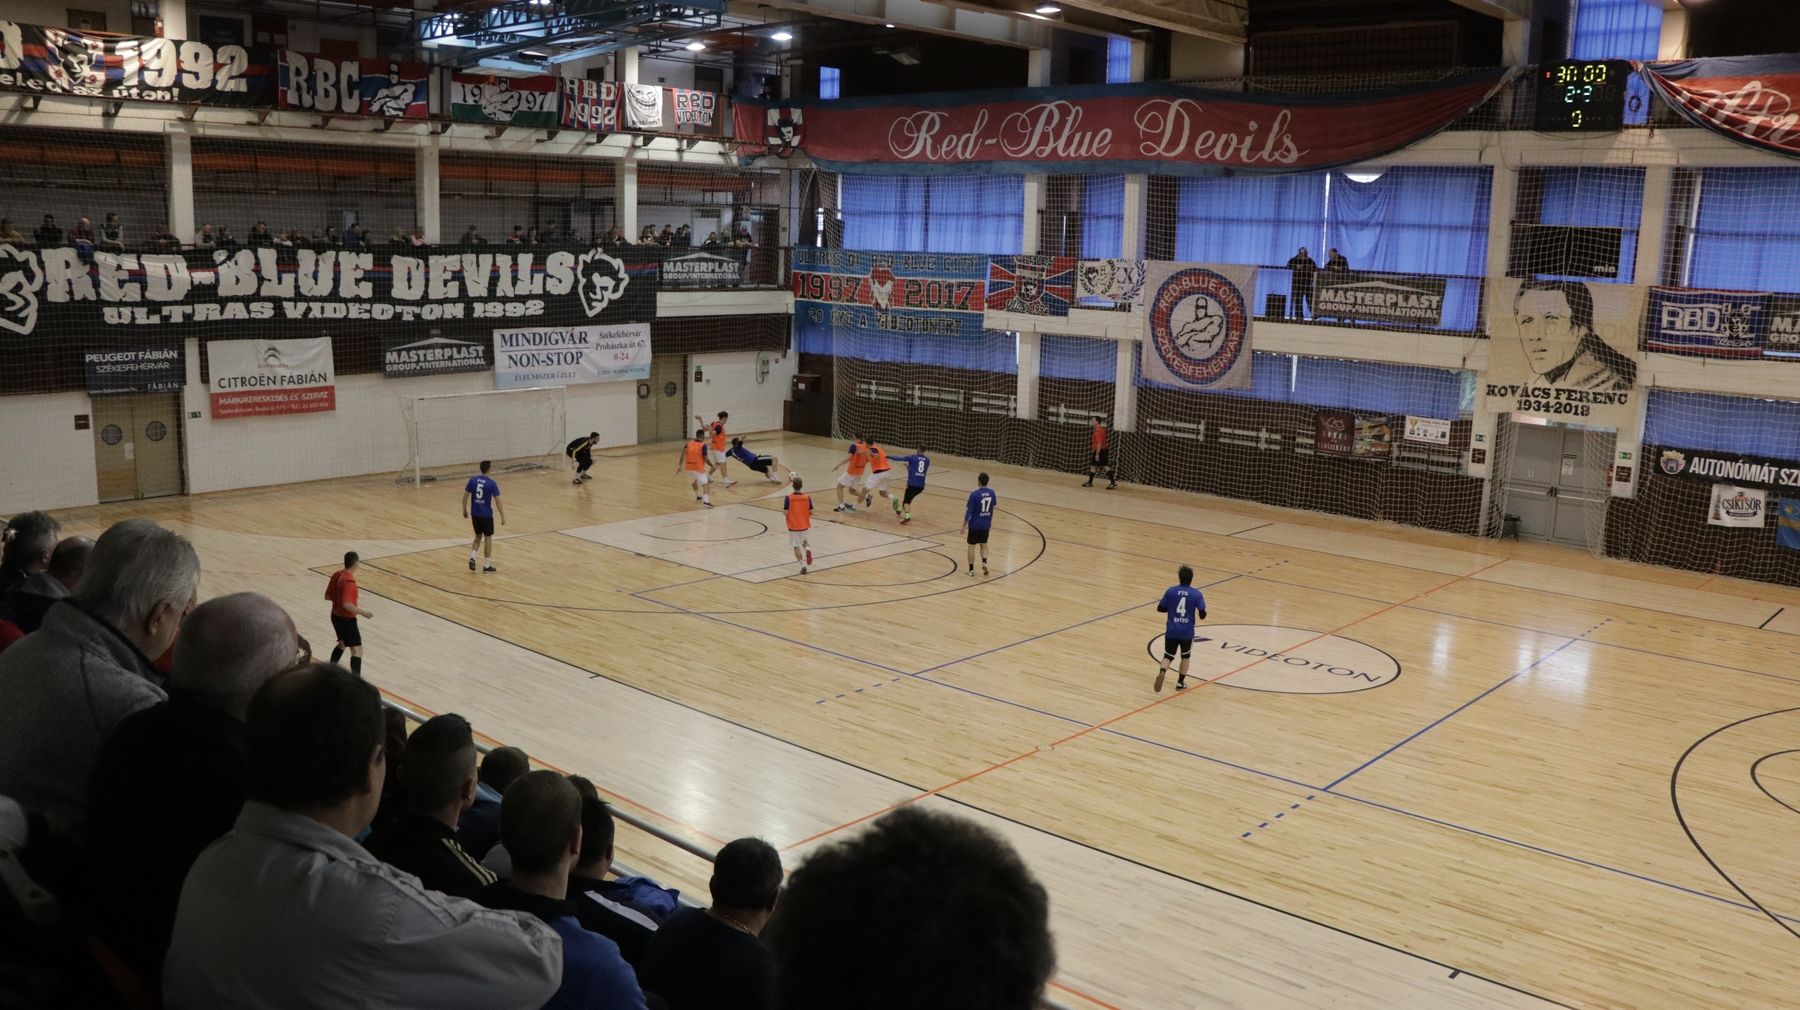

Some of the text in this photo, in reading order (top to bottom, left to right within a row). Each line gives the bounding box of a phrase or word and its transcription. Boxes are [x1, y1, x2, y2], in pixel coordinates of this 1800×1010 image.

[113, 38, 249, 93] 1992
[286, 50, 361, 114] RBC
[565, 78, 616, 100] RBD
[675, 92, 715, 112] RBD
[569, 104, 616, 125] 1992
[888, 98, 1311, 165] Red-Blue Devils
[42, 247, 576, 303] RED-BLUE DEVILS
[663, 261, 740, 273] MASTERPLAST
[799, 272, 978, 309] 1997 2017
[1159, 276, 1241, 314] RED-BLUE CITY
[1319, 288, 1441, 309] MASTERPLAST
[103, 299, 546, 326] ULTRAS VIDEOTON 1992
[858, 315, 868, 328] A
[1355, 304, 1439, 319] INTERNATIONAL
[1661, 306, 1721, 332] RBD
[499, 328, 589, 348] MINDIGVÁR
[85, 348, 178, 363] PEUGEOT FÁBIÁN
[385, 345, 485, 364] MASTERPLAST
[421, 357, 486, 369] INTERNATIONAL
[508, 351, 584, 369] NON-STOP
[613, 352, 630, 361] 0-24
[147, 381, 179, 391] FÁBIÁN
[217, 370, 328, 389] CITROËN FÁBIÁN
[1485, 382, 1629, 405] KOVÁCS FERENC
[1516, 398, 1592, 417] 1934-2018
[917, 460, 925, 473] 8
[1689, 453, 1800, 488] AUTONÓMIÁT SZ
[475, 483, 484, 499] 5
[980, 496, 992, 513] 17
[1175, 596, 1187, 617] 4
[1220, 641, 1382, 683] VIDEOTON
